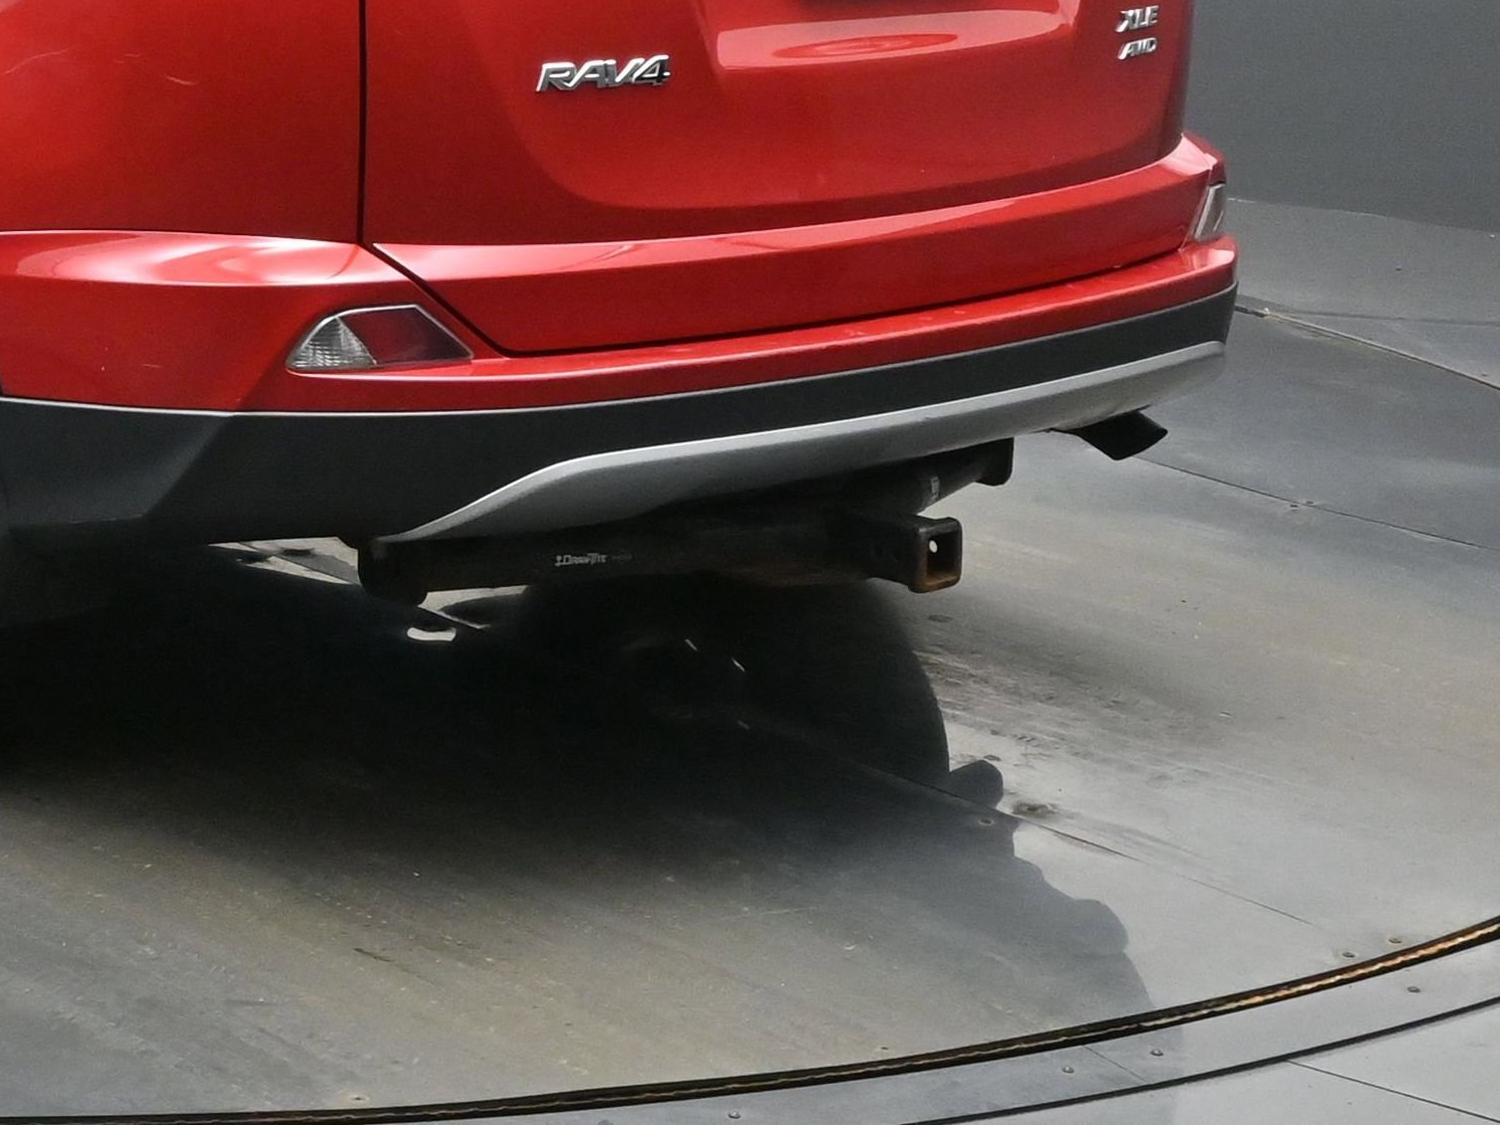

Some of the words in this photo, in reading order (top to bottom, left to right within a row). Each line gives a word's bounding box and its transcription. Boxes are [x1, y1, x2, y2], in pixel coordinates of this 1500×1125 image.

[1115, 5, 1159, 32] XLE
[1117, 37, 1157, 60] AWD
[536, 54, 671, 91] RAV4
